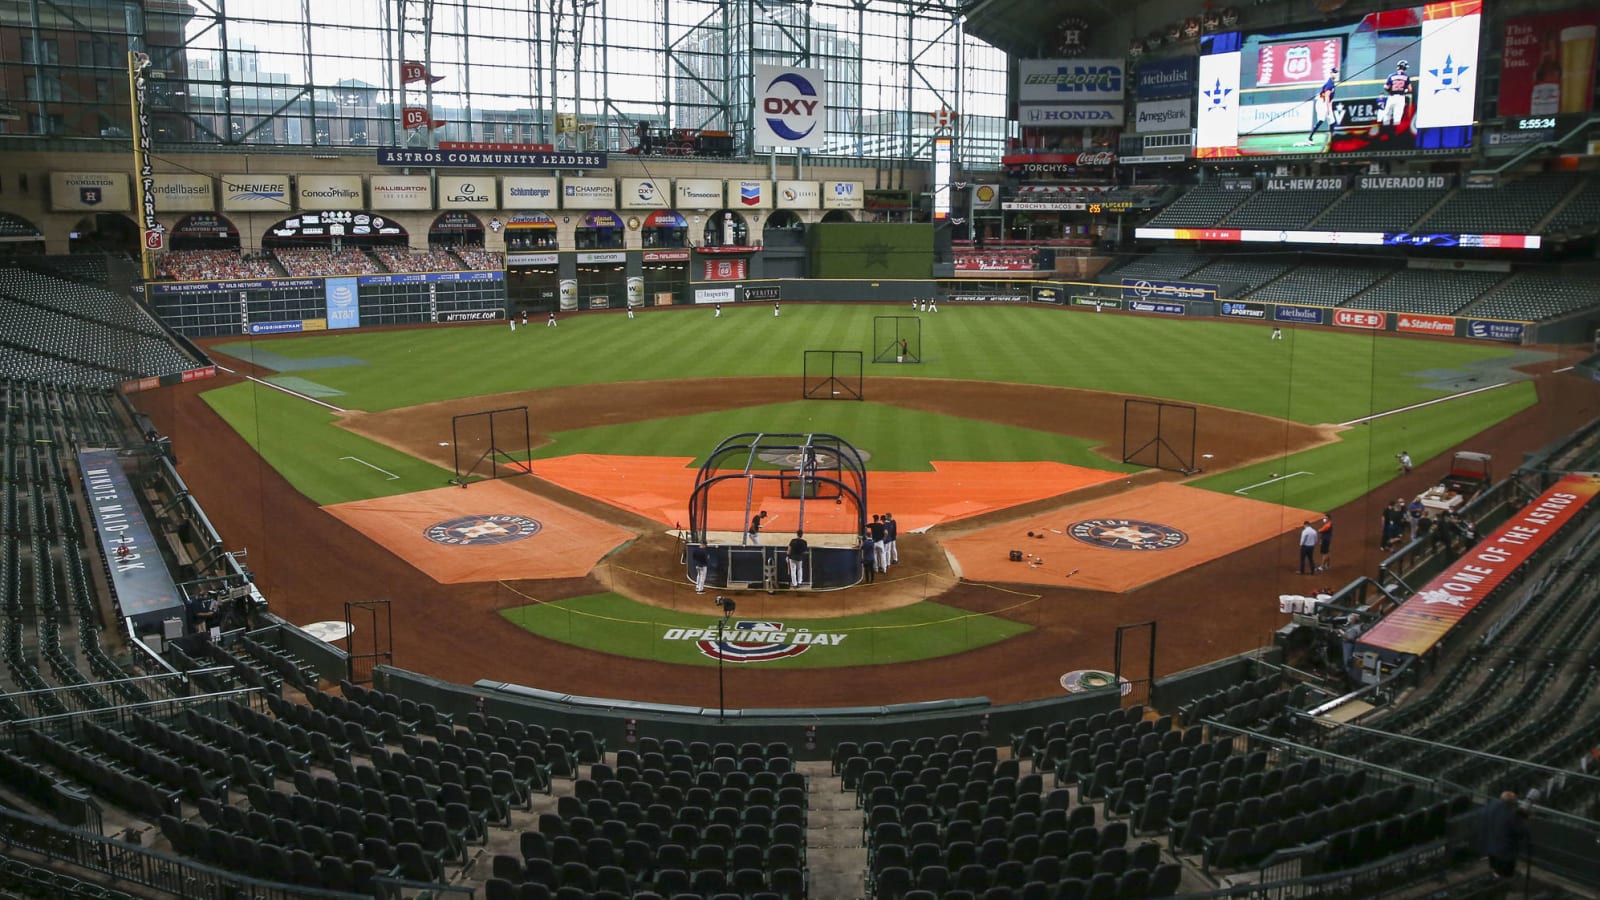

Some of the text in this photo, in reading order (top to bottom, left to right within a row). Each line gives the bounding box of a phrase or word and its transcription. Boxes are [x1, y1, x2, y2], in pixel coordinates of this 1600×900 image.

[1507, 25, 1532, 35] This
[1506, 35, 1537, 46] Bud's
[1504, 48, 1525, 57] For
[1504, 58, 1528, 68] You.
[406, 68, 421, 78] 19
[1141, 70, 1188, 86] Methodist
[1024, 74, 1109, 85] FREEPORT
[1056, 66, 1121, 92] LNG
[764, 98, 818, 116] OXY
[408, 112, 422, 123] 05
[1045, 110, 1114, 120] HONDA
[1518, 118, 1556, 129] 5:55:34
[386, 152, 600, 165] ASTROS COMMUNITY LEADERS
[1076, 152, 1114, 167] Coca-Cola
[1024, 164, 1068, 172] TORCHYS
[228, 184, 285, 192] CHENIERE
[1267, 177, 1444, 190] ALL-NEW 2020 SILVERADO HD
[301, 187, 360, 199] ConocoPhillips
[510, 187, 550, 198] Schlumberger
[144, 180, 156, 228] FARE
[704, 290, 728, 298] Insperity
[331, 311, 354, 319] AT&T
[447, 311, 496, 320] NITTOTIRE.COM
[1231, 309, 1264, 317] SPORTSNET
[1280, 309, 1316, 318] Methodist
[88, 468, 118, 500] MINUTE
[98, 504, 130, 532] MAID
[1478, 546, 1513, 564] OF
[1498, 525, 1539, 546] THE
[1525, 492, 1578, 526] ASTROS
[663, 628, 848, 646] OPENING DAY
